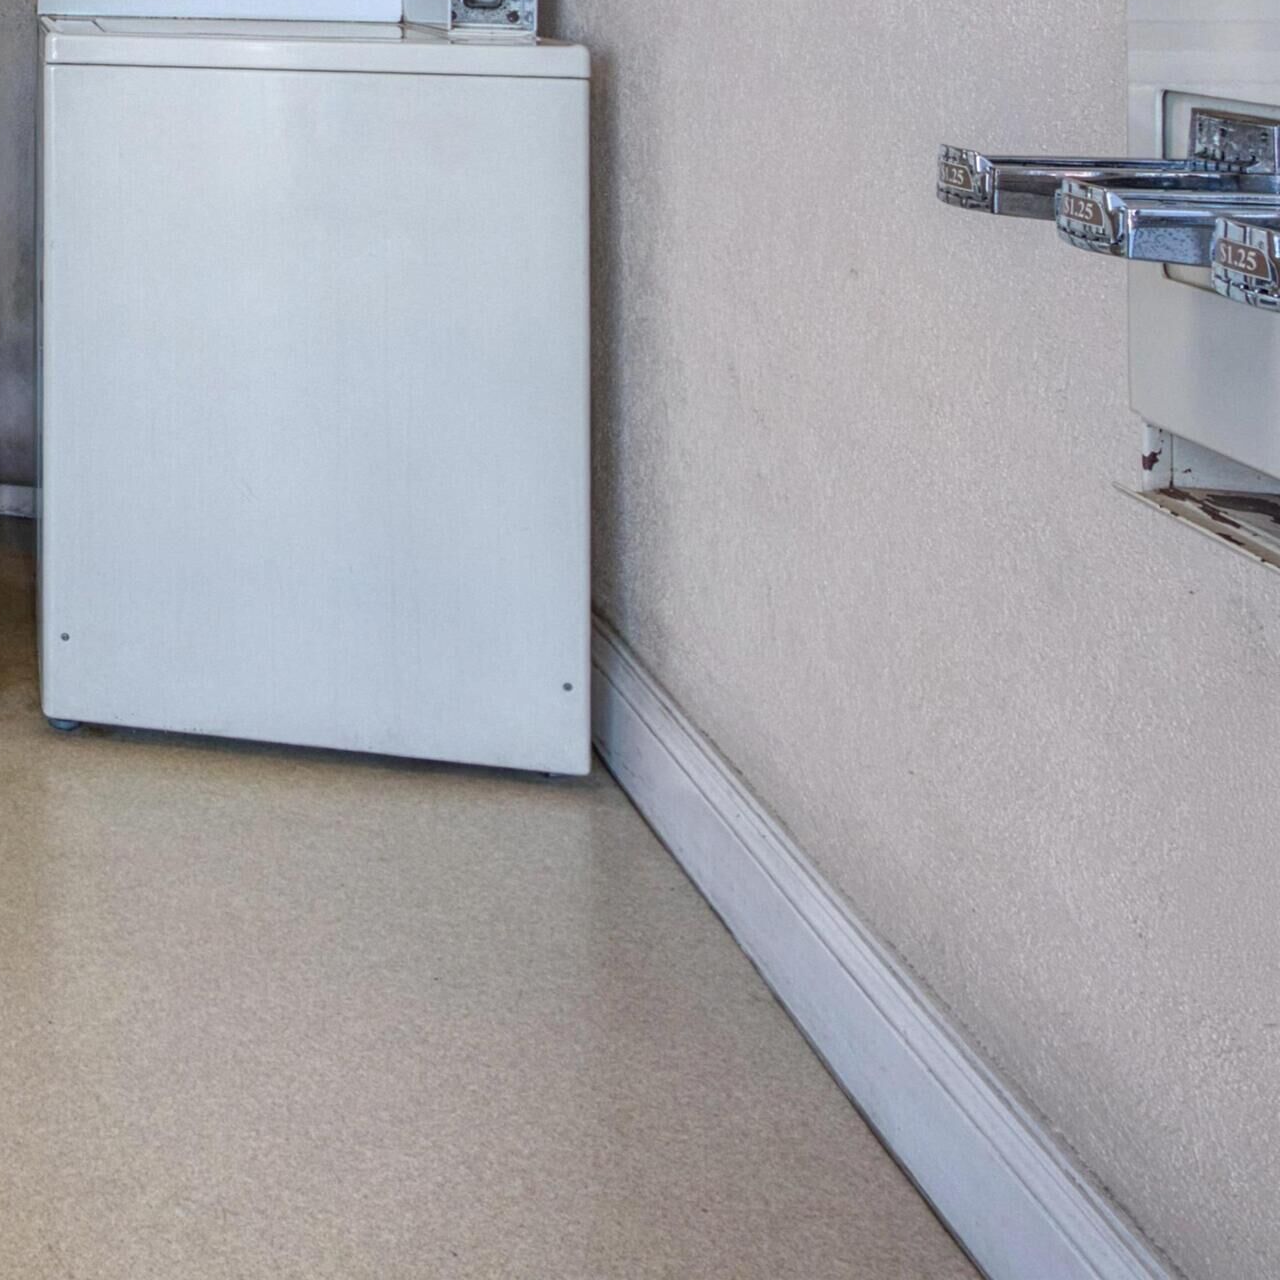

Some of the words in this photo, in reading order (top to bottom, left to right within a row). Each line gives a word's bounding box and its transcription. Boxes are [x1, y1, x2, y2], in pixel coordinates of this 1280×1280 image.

[941, 166, 964, 185] $1.25
[1064, 195, 1093, 220] $1.25
[1219, 242, 1257, 270] $1.25
